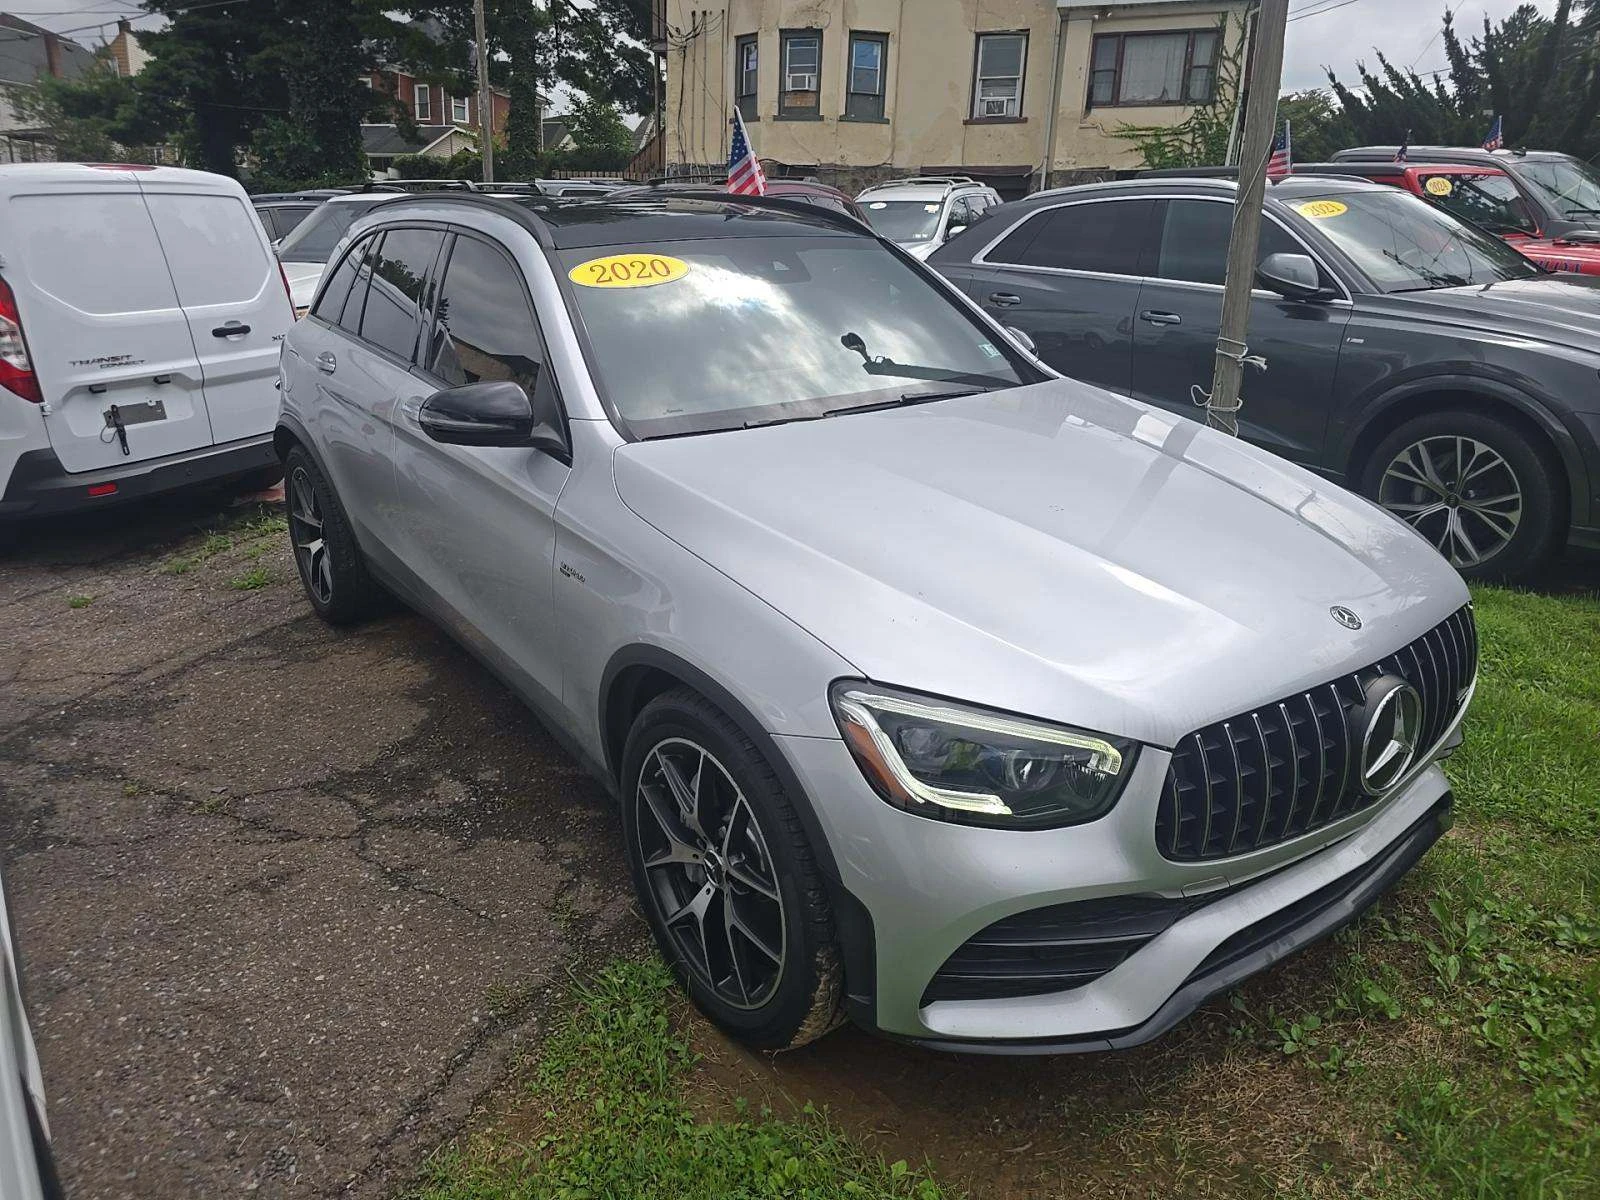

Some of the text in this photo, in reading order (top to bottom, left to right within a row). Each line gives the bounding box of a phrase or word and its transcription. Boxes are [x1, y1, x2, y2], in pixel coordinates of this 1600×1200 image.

[1303, 202, 1342, 217] 2021
[589, 258, 671, 284] 2020
[68, 354, 133, 368] TRANSIT
[99, 359, 146, 369] CONNECT
